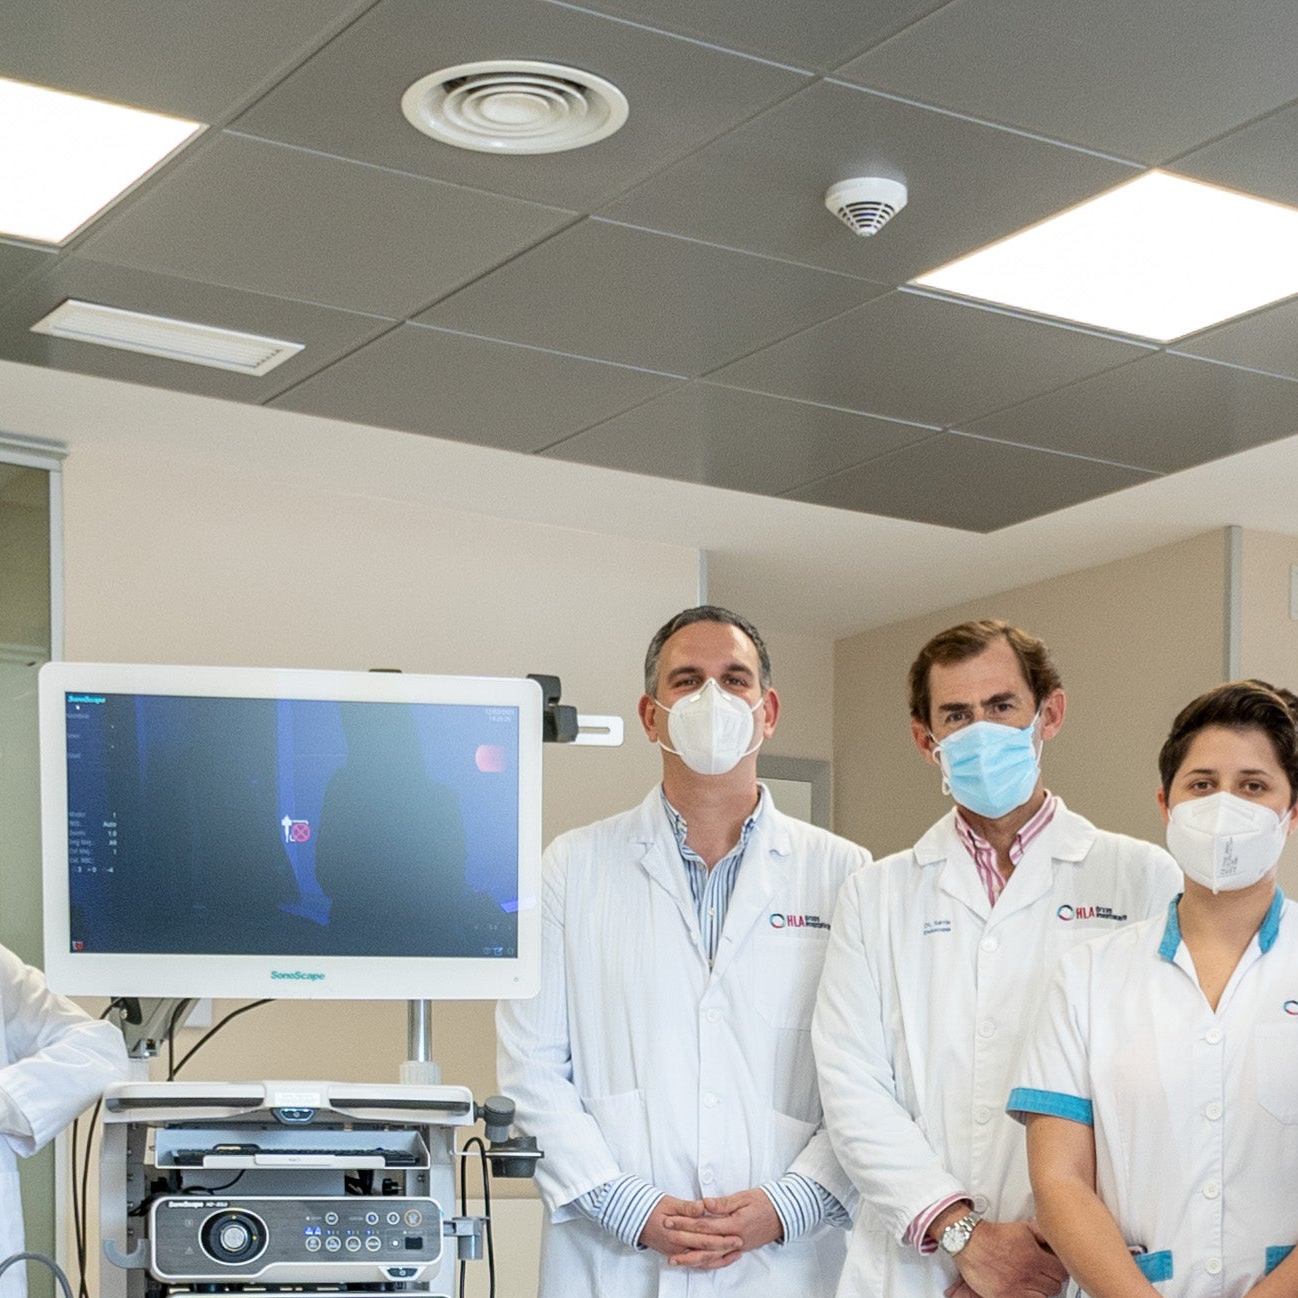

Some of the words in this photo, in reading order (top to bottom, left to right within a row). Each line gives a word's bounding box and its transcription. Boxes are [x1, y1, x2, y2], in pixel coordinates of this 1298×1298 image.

[1076, 906, 1095, 919] HLA
[786, 914, 806, 927] HLA
[270, 970, 326, 981] SonoScape
